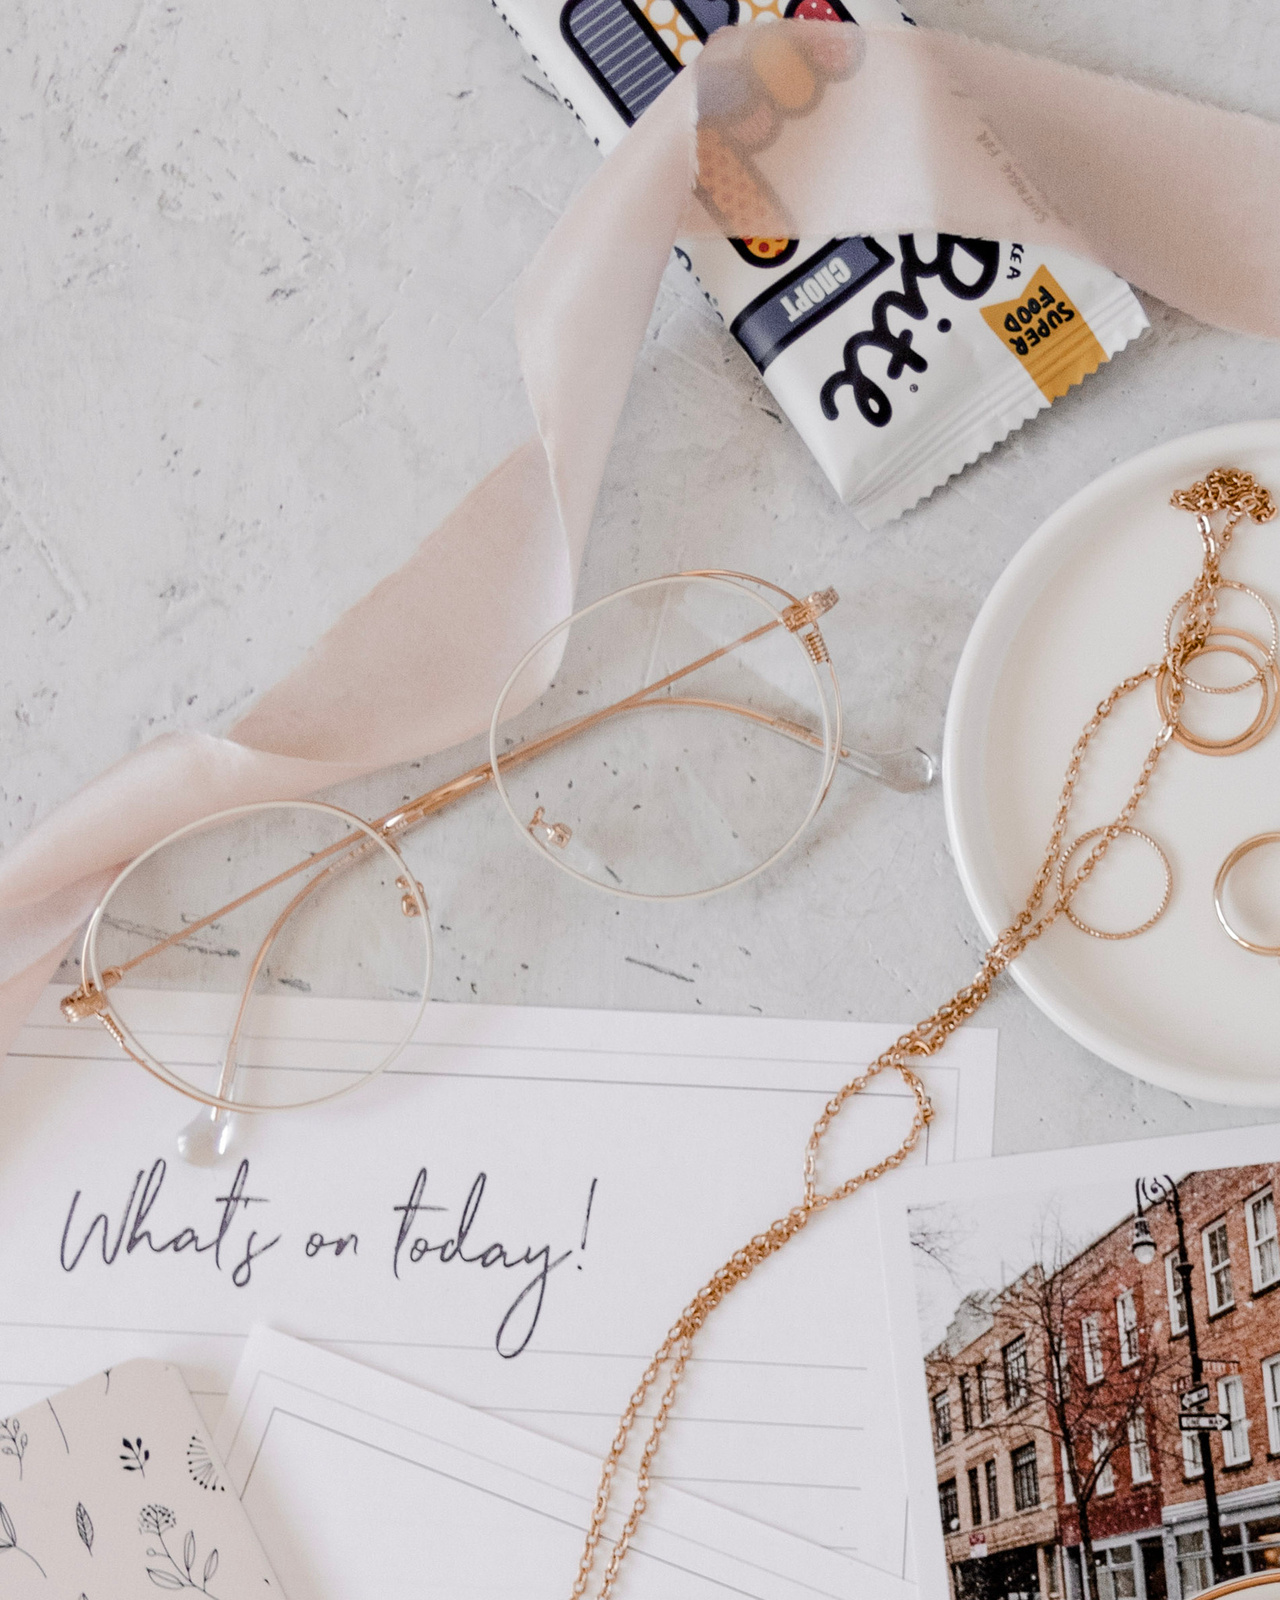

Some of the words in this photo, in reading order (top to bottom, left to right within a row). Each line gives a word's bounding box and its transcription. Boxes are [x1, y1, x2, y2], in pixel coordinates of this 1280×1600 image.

[778, 257, 852, 323] СПОРТ
[1004, 285, 1056, 332] FOOD
[1009, 301, 1075, 355] SUPER
[304, 1229, 360, 1257] on
[393, 1166, 598, 1359] today!
